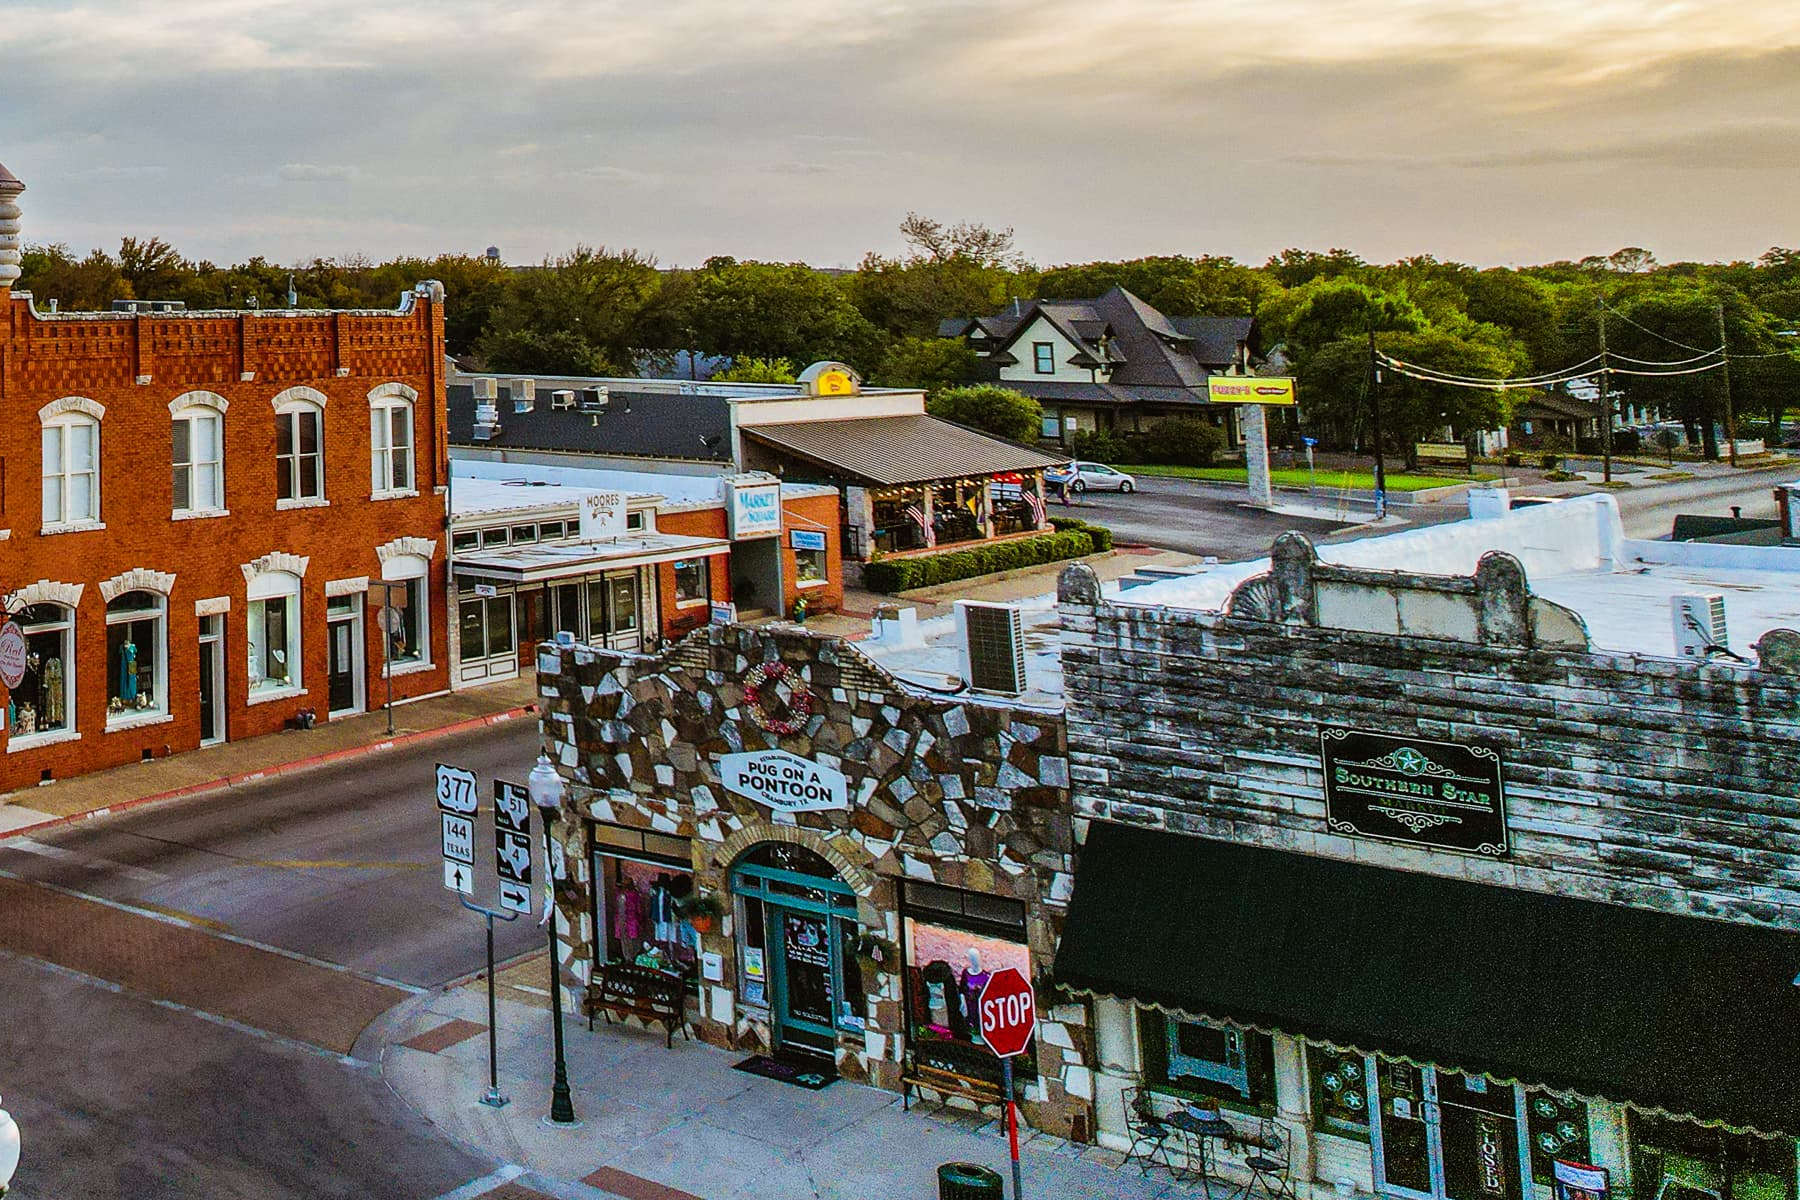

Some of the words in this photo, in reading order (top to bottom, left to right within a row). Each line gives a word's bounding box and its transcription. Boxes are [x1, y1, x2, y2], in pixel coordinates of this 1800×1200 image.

[587, 494, 620, 508] MOORES
[748, 762, 778, 776] PUG
[782, 767, 804, 781] ON
[810, 772, 821, 784] A
[441, 775, 472, 804] 377
[738, 773, 833, 803] PONTOON
[1335, 766, 1435, 797] SOUTHERN
[1442, 782, 1491, 806] STAR
[509, 798, 521, 813] 51
[1378, 798, 1449, 814] MARKET
[446, 821, 467, 840] 144
[447, 842, 470, 858] TEXAS
[512, 849, 520, 862] 4
[984, 992, 1031, 1032] STOP
